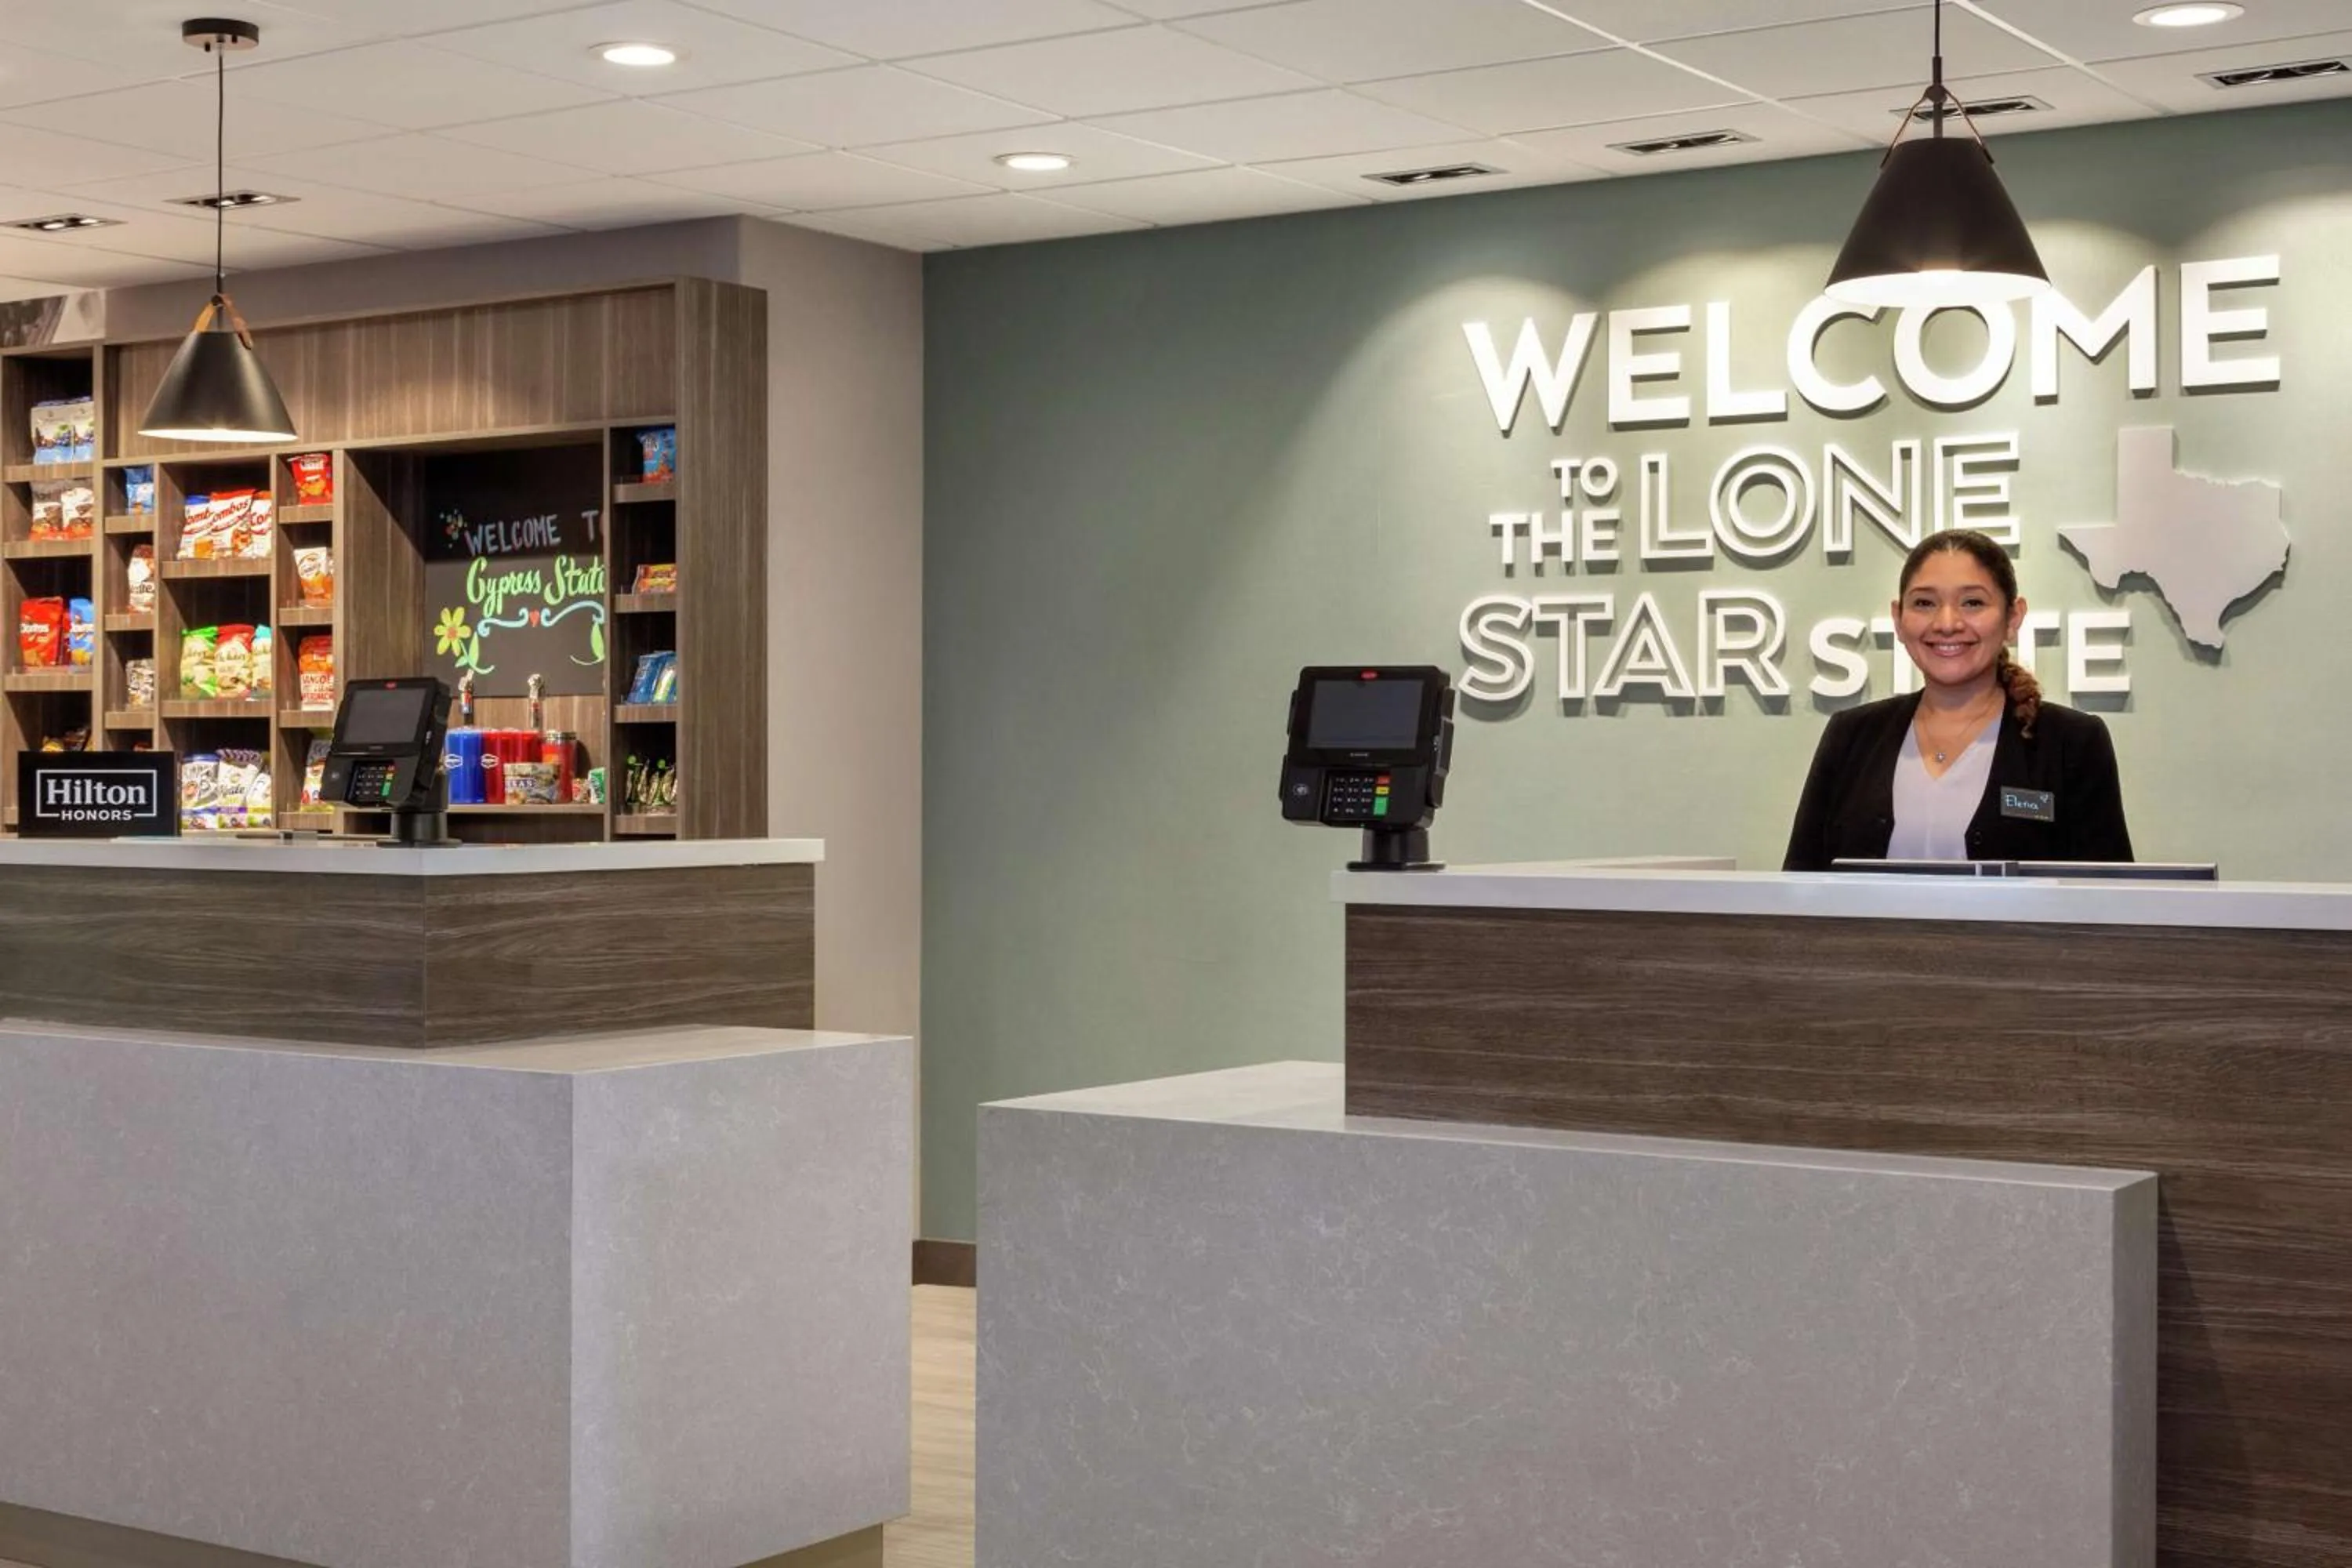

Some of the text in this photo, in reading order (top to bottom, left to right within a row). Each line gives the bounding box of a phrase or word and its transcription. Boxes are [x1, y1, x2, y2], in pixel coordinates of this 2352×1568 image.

[1463, 254, 2280, 430] WELCOME
[1490, 432, 2020, 564] THE LONE
[1551, 457, 1618, 498] TO
[464, 510, 604, 557] WELCOME T
[466, 556, 541, 618] Cypress
[1458, 590, 2131, 702] STAR STTE
[46, 779, 147, 805] Hilton
[61, 810, 132, 820] HONORS
